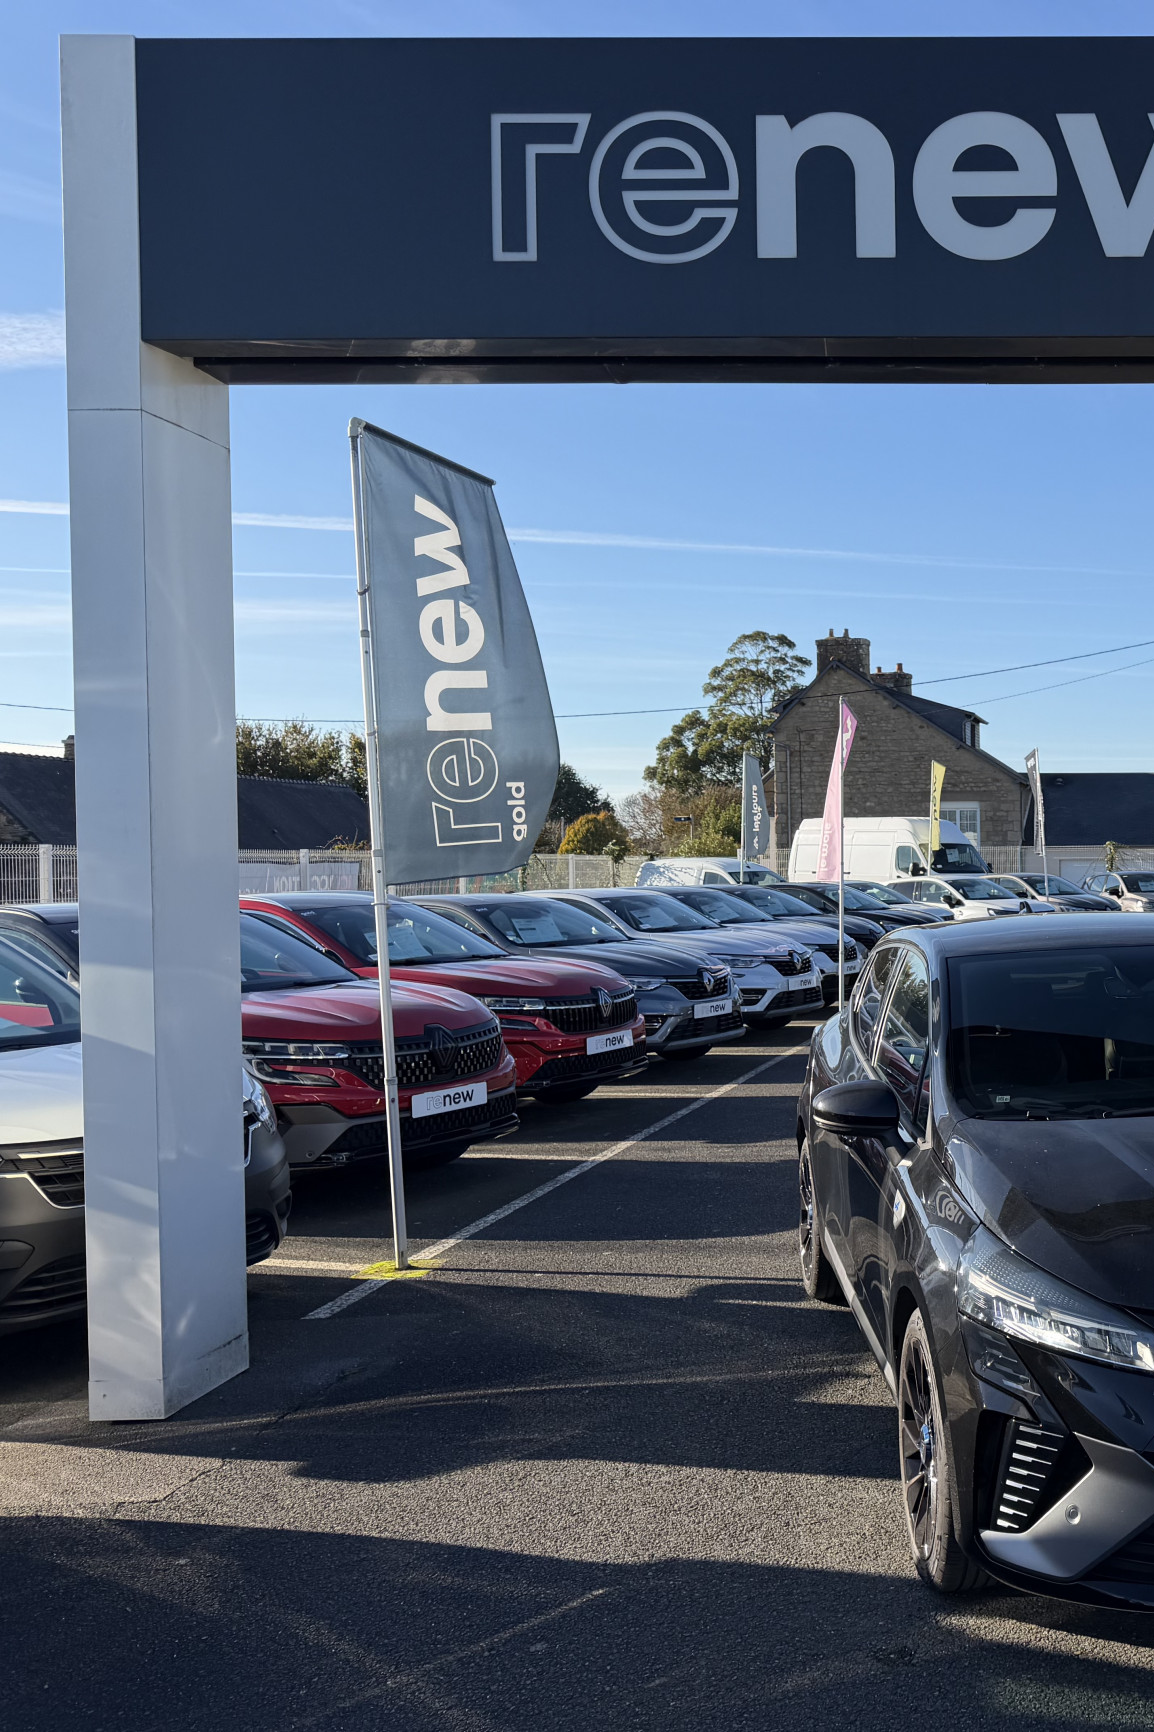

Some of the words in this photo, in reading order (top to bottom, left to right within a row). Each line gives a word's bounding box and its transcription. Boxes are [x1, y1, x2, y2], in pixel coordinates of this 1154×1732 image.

[413, 493, 503, 847] renew
[506, 781, 528, 842] gold
[426, 1087, 475, 1111] renew
